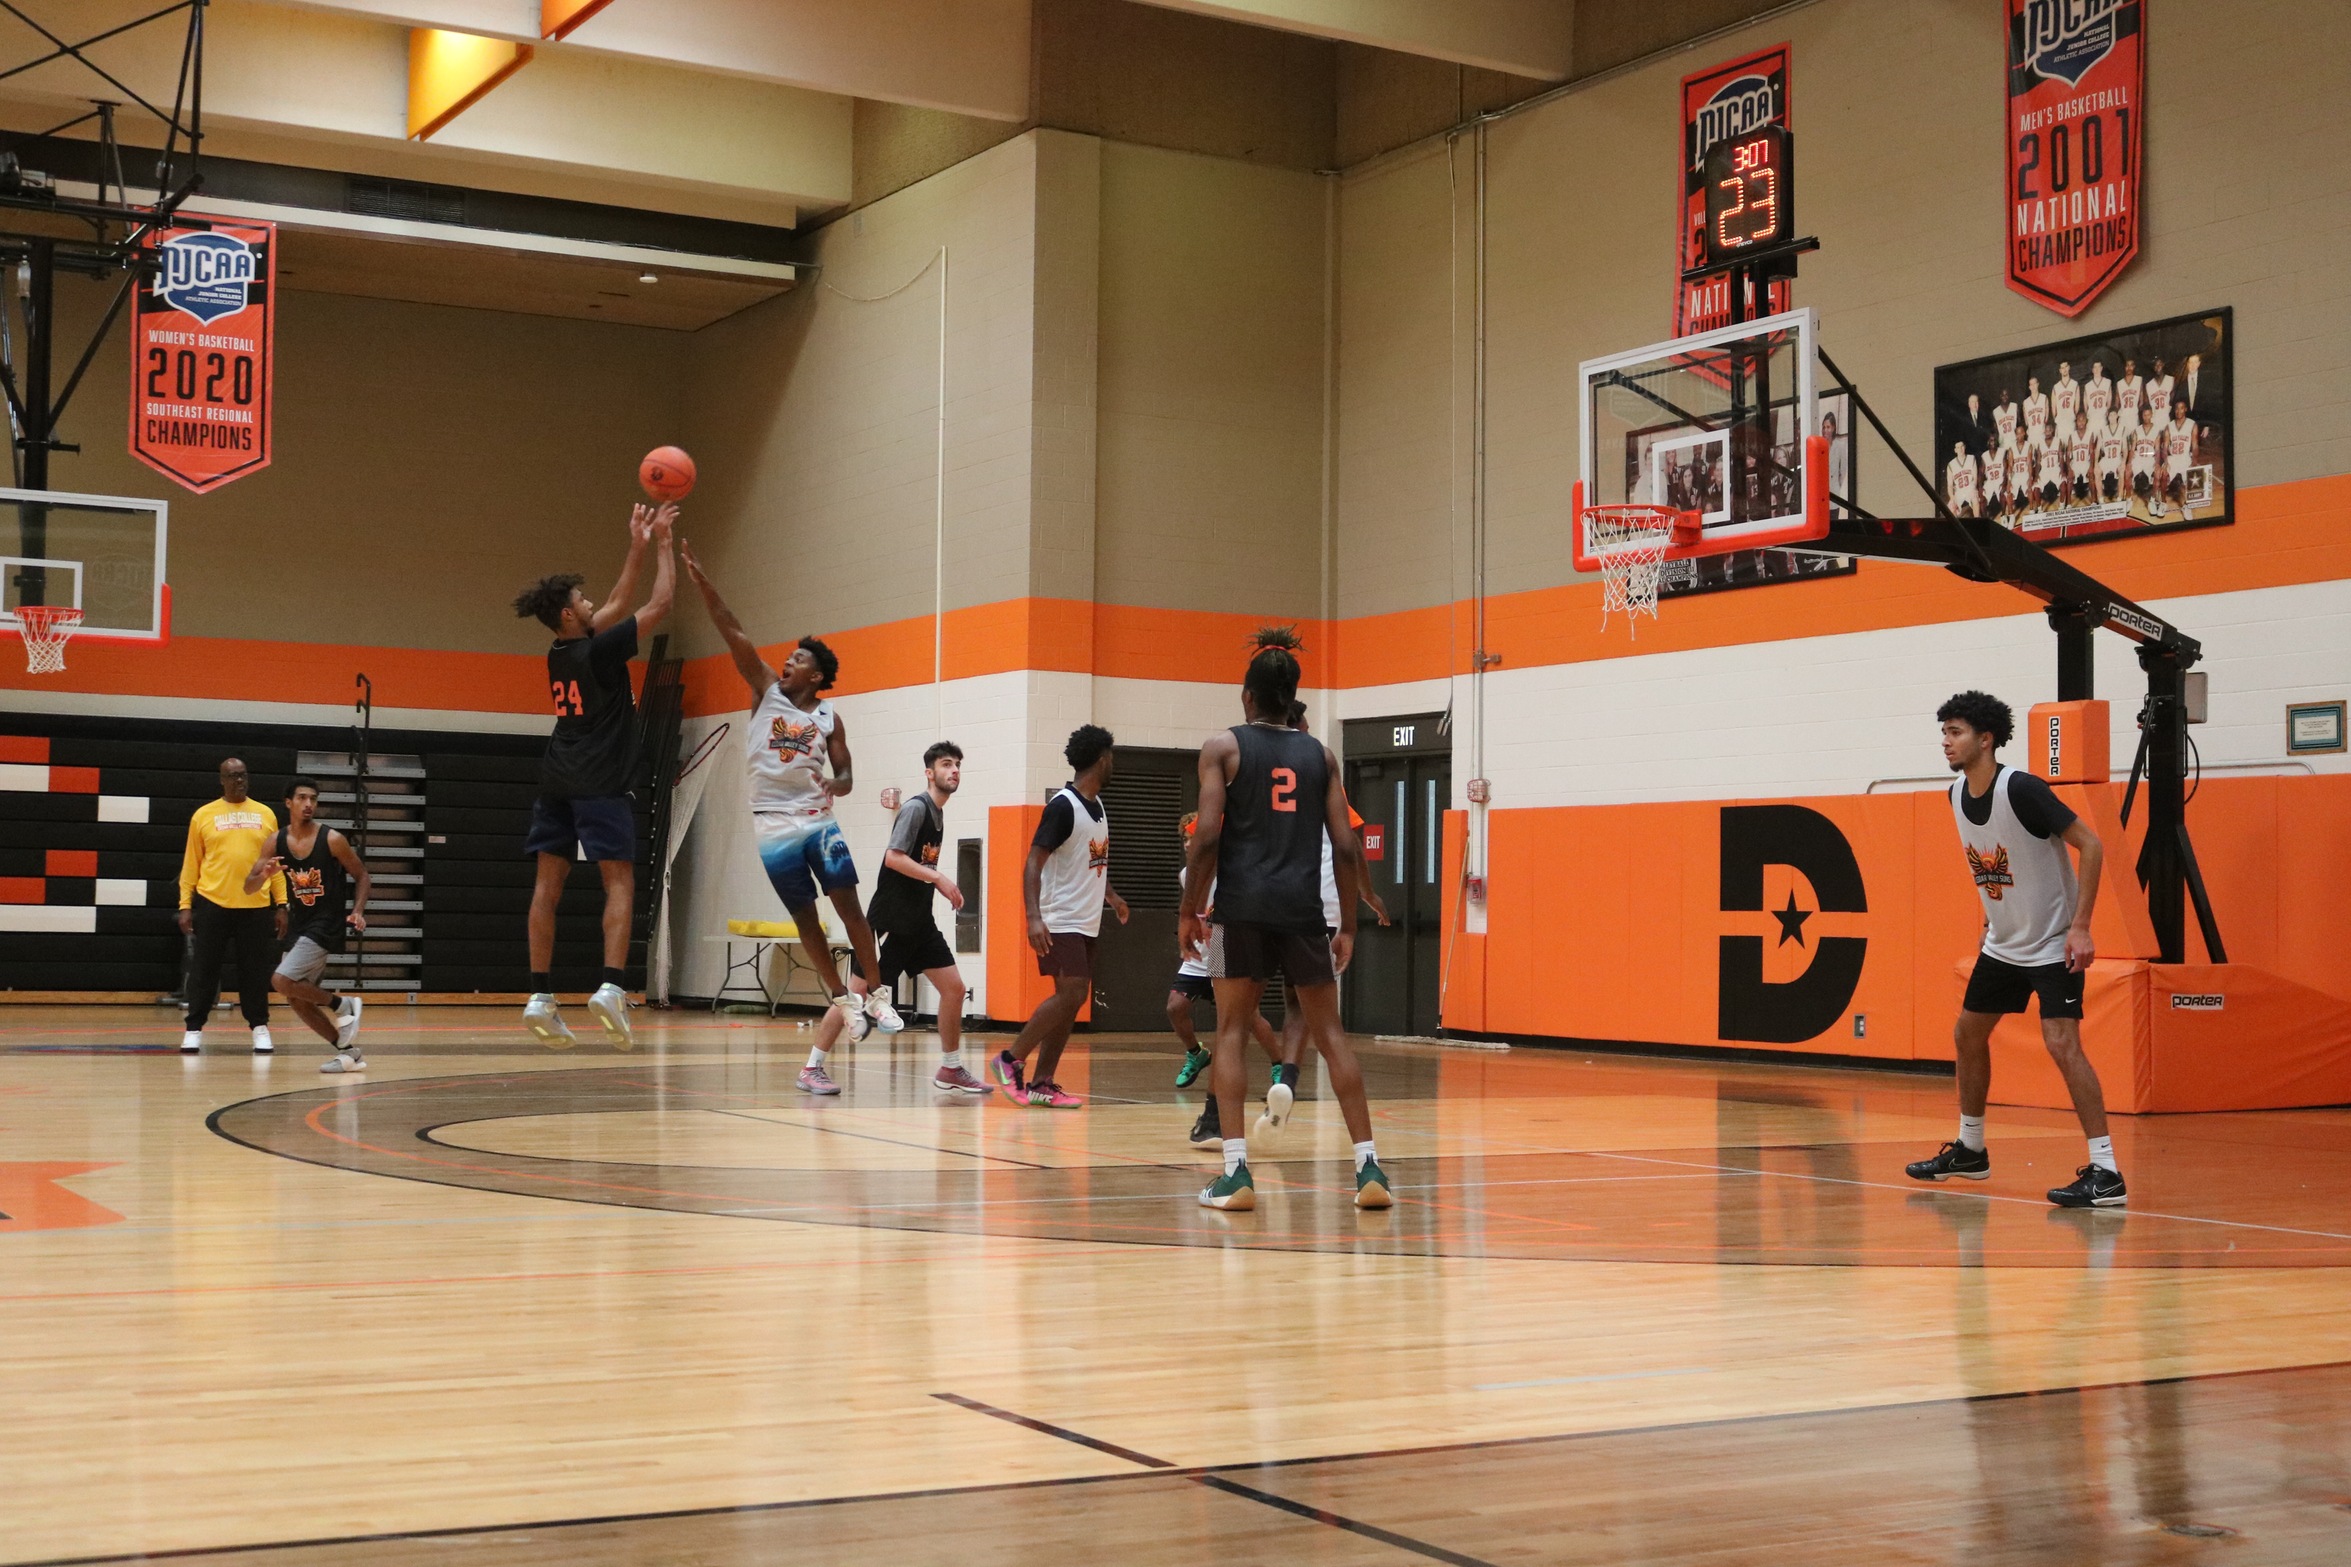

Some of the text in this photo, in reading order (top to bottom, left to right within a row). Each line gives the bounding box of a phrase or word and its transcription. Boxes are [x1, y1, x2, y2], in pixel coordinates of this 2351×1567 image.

[2067, 32, 2110, 50] JUNIOR COLLEGE
[2084, 24, 2110, 38] NATIONAL
[2054, 40, 2110, 63] ATHLETIC ASSOCIATION
[2020, 86, 2128, 132] MEN'S BASKETBALL
[1734, 139, 1768, 172] 3:07
[2018, 107, 2130, 200] 2001
[1719, 167, 1776, 246] 23
[2017, 180, 2126, 236] NATIONAL
[2018, 215, 2127, 273] CHAMPIONS
[159, 246, 250, 289] NJCAA
[1691, 277, 1776, 318] NATINL
[149, 330, 254, 352] WOMEN'S BASKETBALL
[148, 347, 253, 405] 2020
[147, 402, 253, 423] SOUTHEAST REGIONAL
[147, 419, 252, 451] CHAMPIONS
[553, 680, 584, 716] 24
[1394, 726, 1414, 746] EXIT
[1272, 768, 1296, 812] 2
[214, 812, 262, 826] DALLAS COLLEGE
[1366, 836, 1380, 849] EXIT
[1027, 1090, 1054, 1104] NIKE
